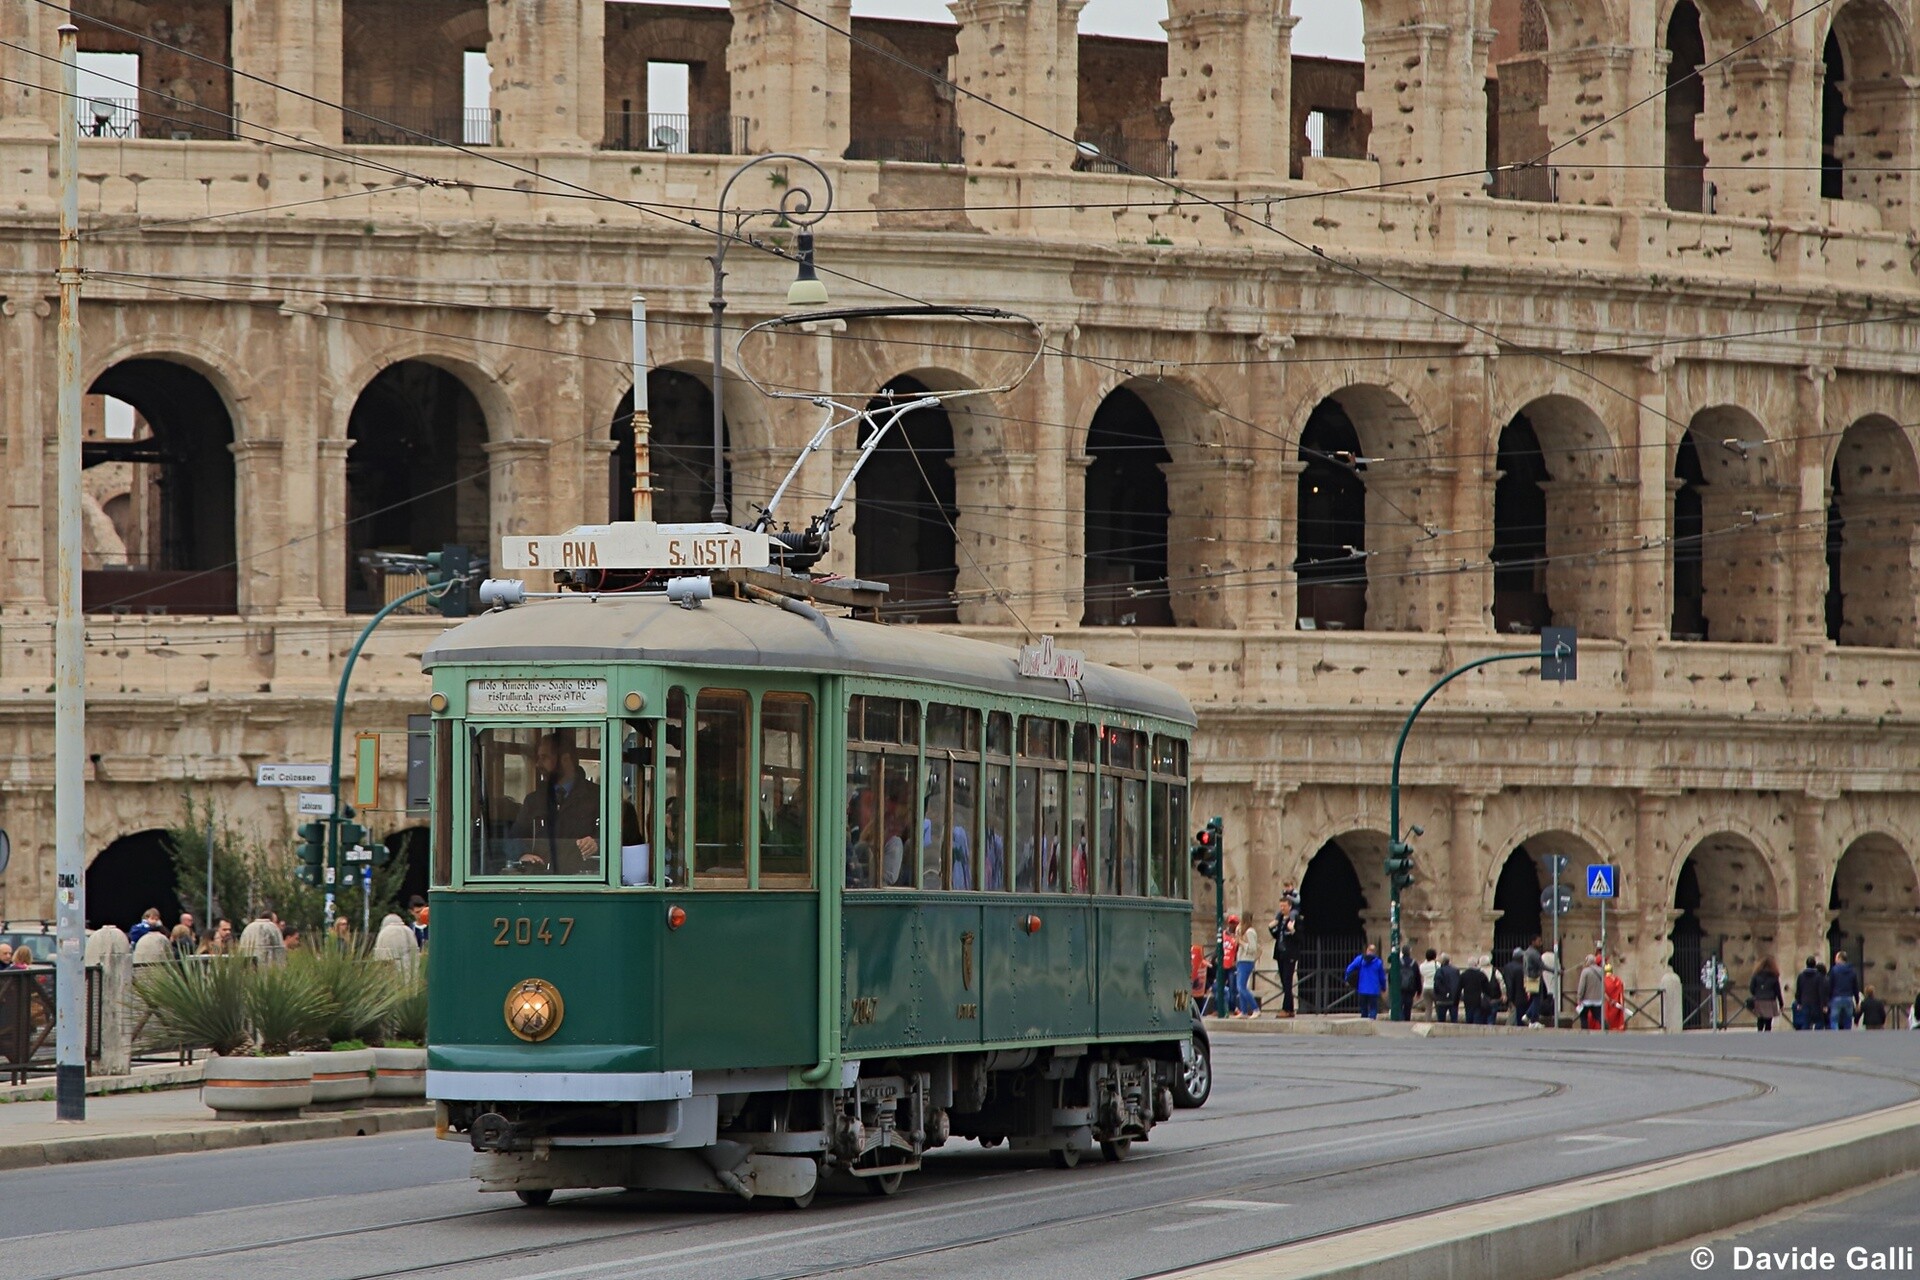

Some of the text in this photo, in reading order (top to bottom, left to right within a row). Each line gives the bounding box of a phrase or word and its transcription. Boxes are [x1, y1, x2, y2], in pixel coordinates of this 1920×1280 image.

[577, 680, 598, 690] 1929
[563, 691, 587, 701] ATAC
[262, 772, 317, 781] del Colosseo
[493, 917, 576, 946] 2047
[851, 996, 878, 1025] 2047
